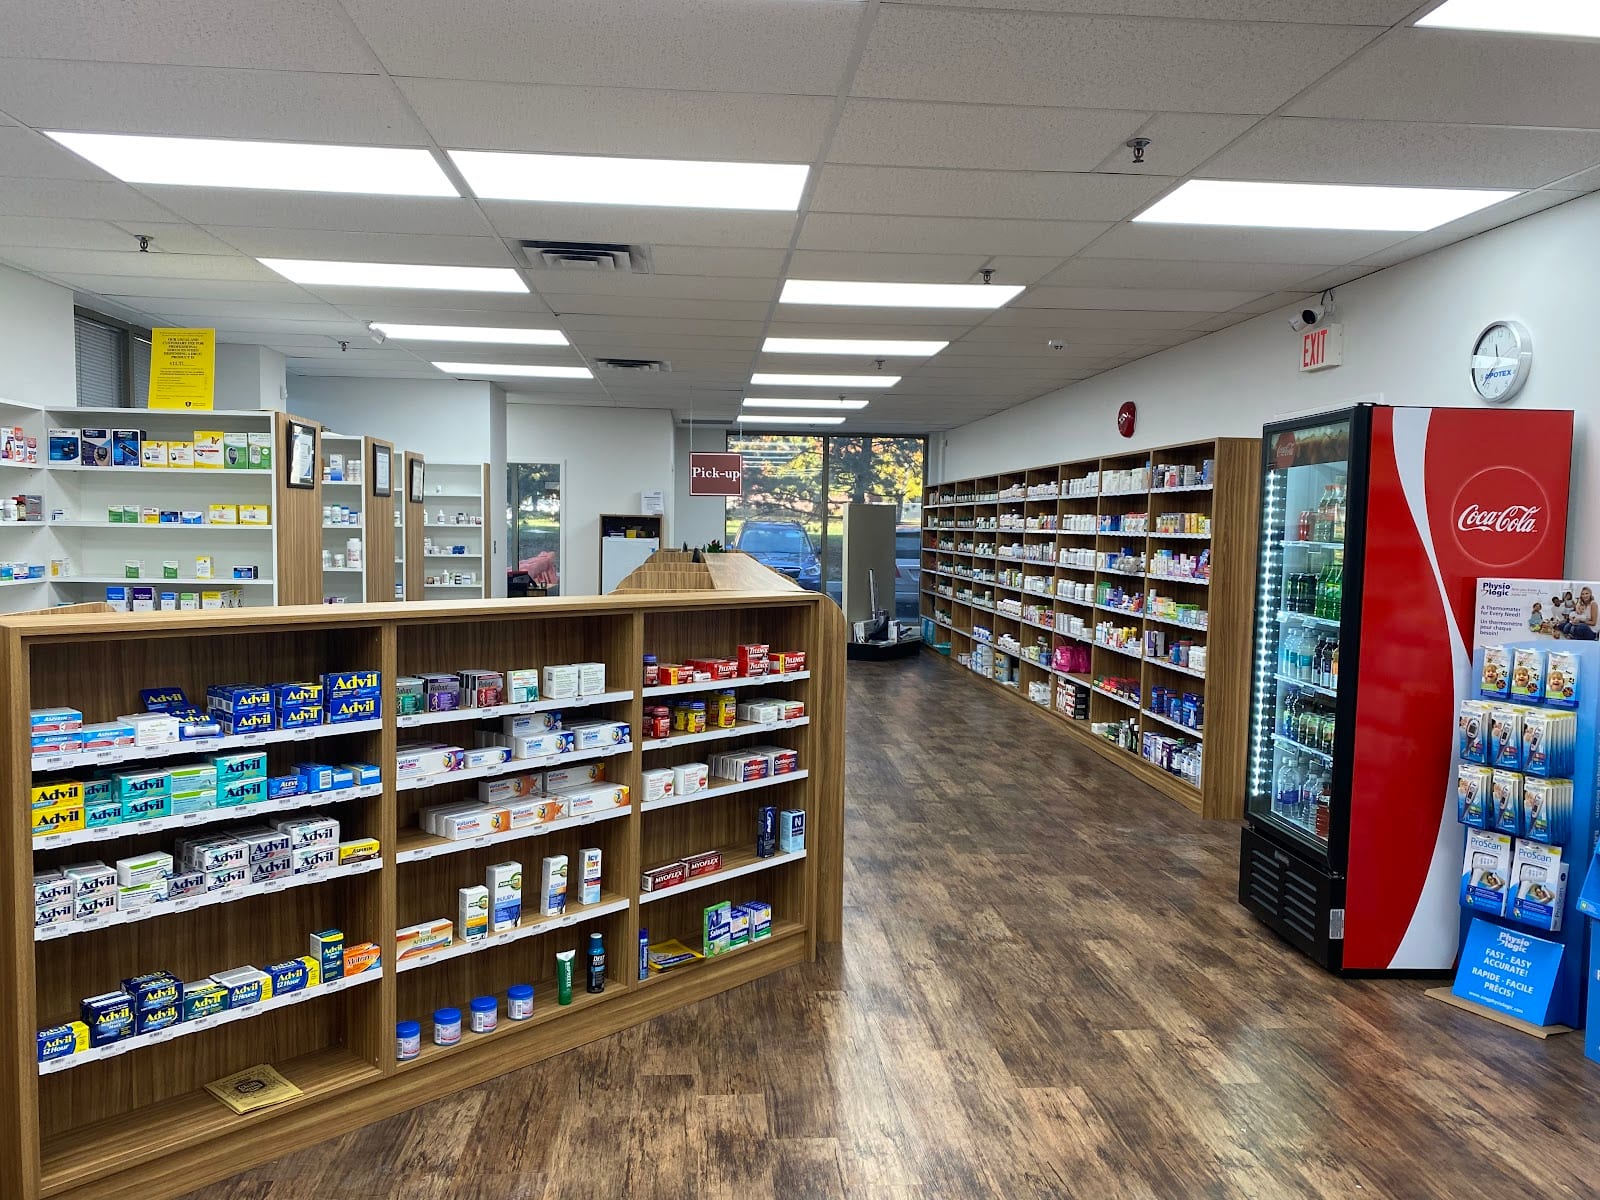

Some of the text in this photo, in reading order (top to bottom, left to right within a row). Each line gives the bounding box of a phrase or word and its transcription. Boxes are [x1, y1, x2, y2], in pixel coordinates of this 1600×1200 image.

[1303, 329, 1328, 367] EXIT
[691, 466, 741, 482] Pick-up
[1458, 504, 1542, 533] Coca-Cola
[1482, 582, 1510, 590] Physio
[1489, 589, 1509, 598] logic
[333, 673, 378, 691] Advil
[147, 693, 183, 704] Advil
[239, 692, 270, 706] Advil
[287, 688, 318, 700] Advil
[338, 700, 375, 714] Advil
[238, 714, 271, 727] Advil
[288, 710, 318, 722] Advil
[226, 760, 260, 774] Advil
[128, 778, 164, 792] Advil
[226, 784, 260, 798] Advil
[37, 786, 78, 802] Advil
[129, 799, 164, 814] Advil
[38, 810, 79, 826] Advil
[88, 808, 122, 821] Advil
[300, 828, 333, 843] Advil
[252, 838, 290, 854] Advil
[1470, 837, 1502, 850] ProScan
[211, 850, 243, 864] Advil
[301, 850, 334, 866] Advil
[1519, 848, 1552, 862] ProScan
[254, 858, 291, 875] Advil
[690, 857, 720, 870] MYOFLEX
[78, 875, 115, 892] Advil
[168, 876, 204, 892] Advil
[212, 870, 245, 885] Advil
[654, 869, 683, 884] MYOFLEX
[38, 886, 72, 901] Advil
[78, 896, 114, 914] Advil
[38, 906, 71, 920] Advil
[1499, 932, 1530, 947] Physio
[324, 944, 343, 955] Advil
[1504, 942, 1528, 954] logic
[1485, 948, 1532, 969] FAST EASY
[276, 968, 303, 982] Advil
[1483, 957, 1528, 978] ACCURATE!
[284, 978, 300, 987] Hour
[1472, 966, 1534, 994] RAPIDE FACILE
[146, 984, 177, 1002] Advil
[232, 982, 258, 997] Advil
[192, 994, 222, 1010] Advil
[96, 1006, 130, 1024] Advil
[146, 1006, 177, 1024] Advil
[42, 1035, 72, 1049] Advil
[50, 1044, 70, 1054] Hour
